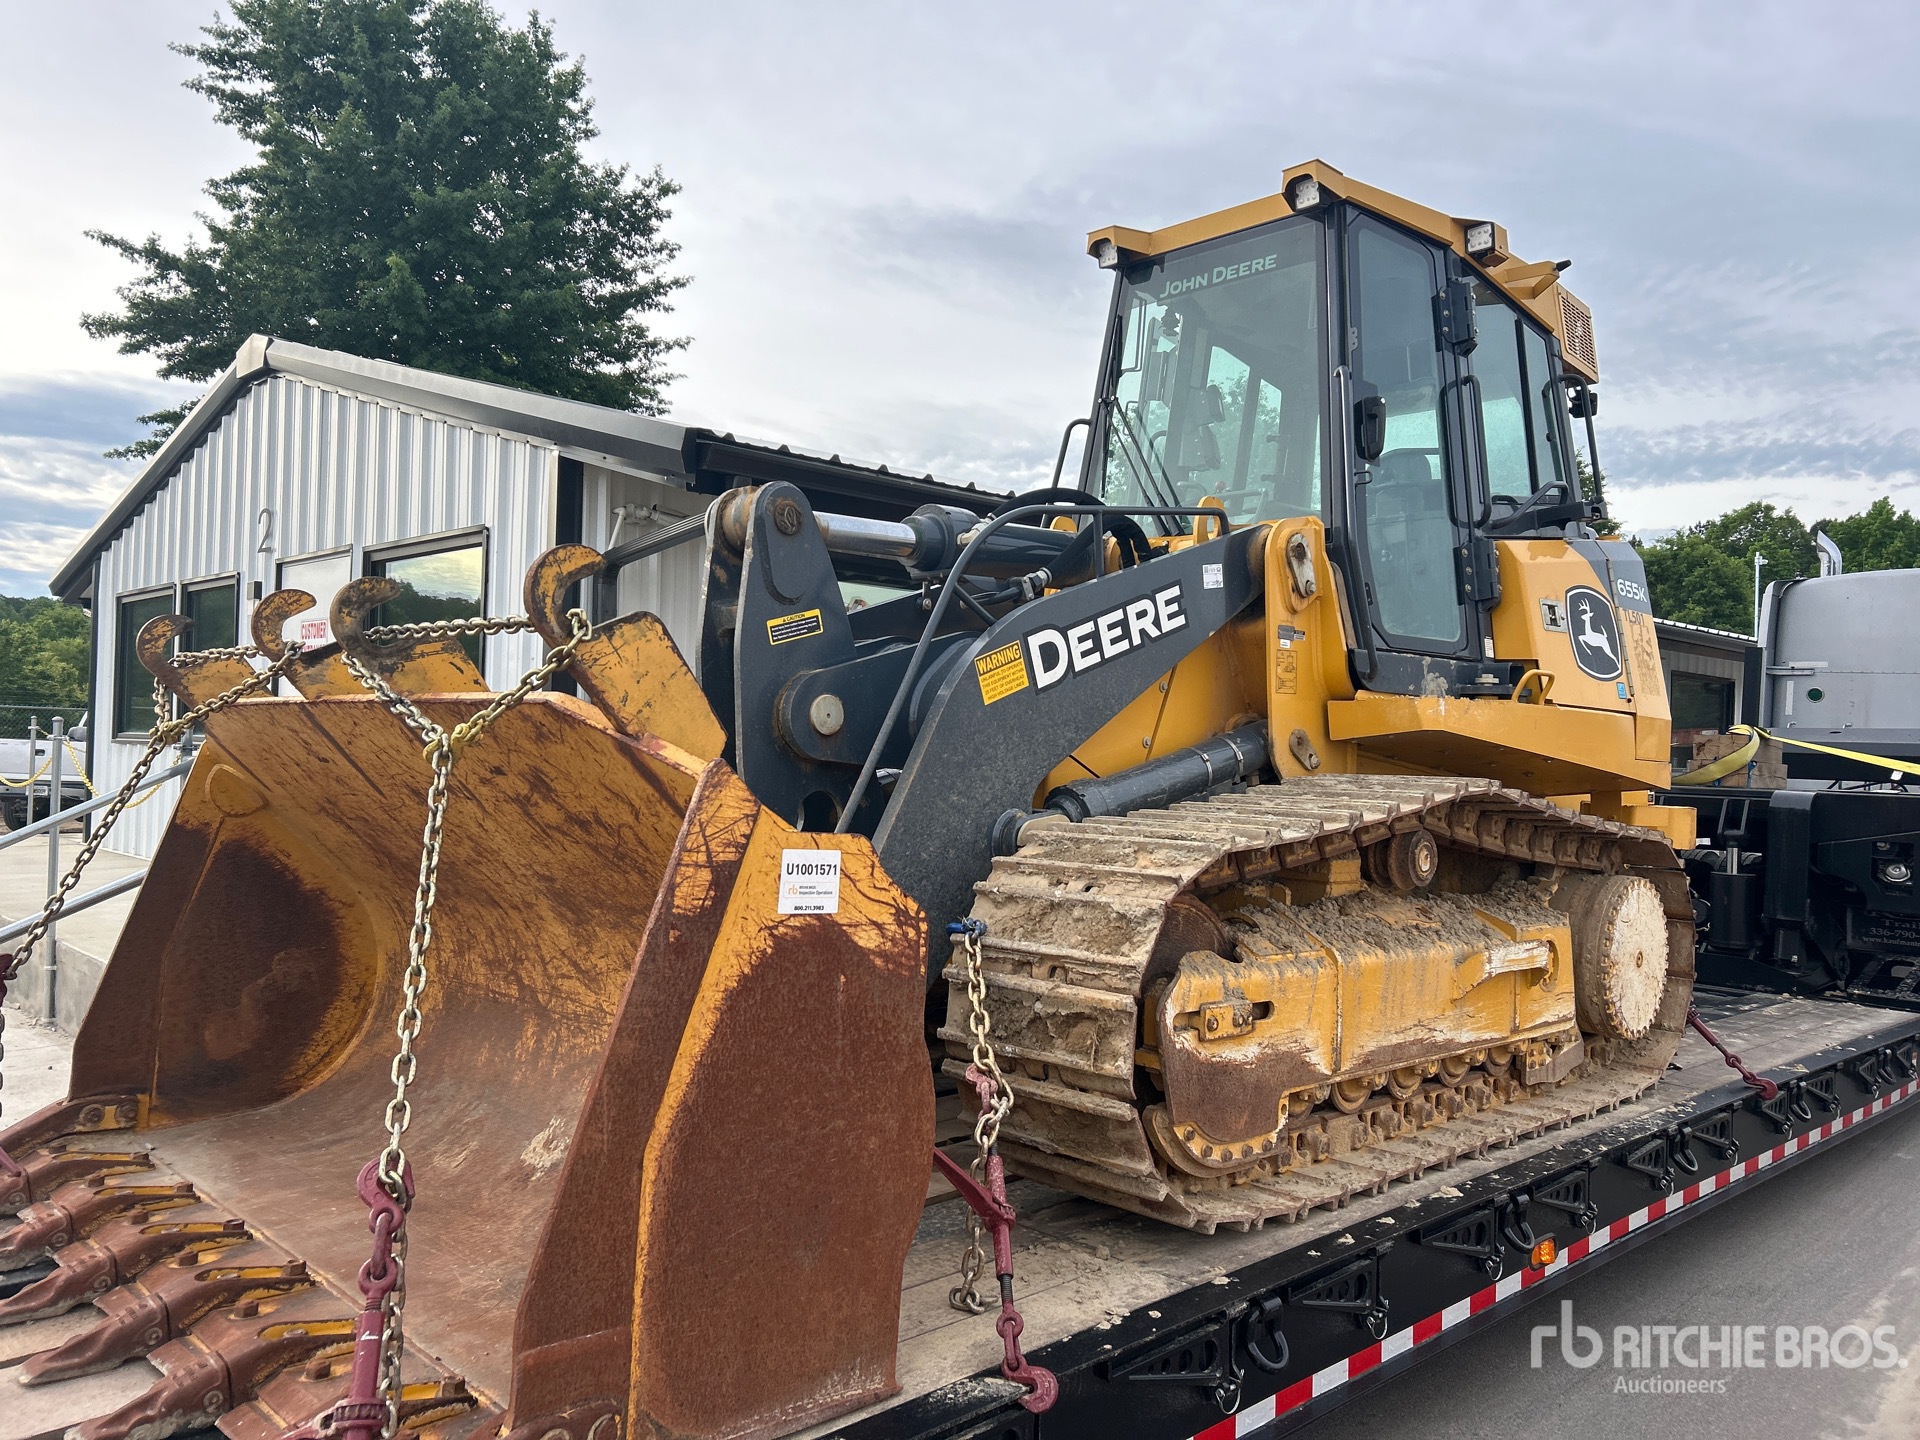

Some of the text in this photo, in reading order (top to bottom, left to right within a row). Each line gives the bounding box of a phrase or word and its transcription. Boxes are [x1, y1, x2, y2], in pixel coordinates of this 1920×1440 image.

[1160, 254, 1277, 298] JOHN DEERE
[257, 507, 272, 553] 2
[1617, 578, 1647, 602] 655K
[786, 613, 806, 622] CAUTION
[301, 621, 327, 640] CUSTOMER
[1027, 585, 1186, 689] DEERE
[977, 644, 1021, 674] WARNING
[981, 671, 1001, 683] UNLAWFUL
[1007, 661, 1022, 672] OPERATE
[991, 673, 1011, 686] EQUIPMENT
[1014, 681, 1025, 689] LINES
[786, 863, 838, 876] U1001571
[1869, 927, 1920, 938] 336-790-
